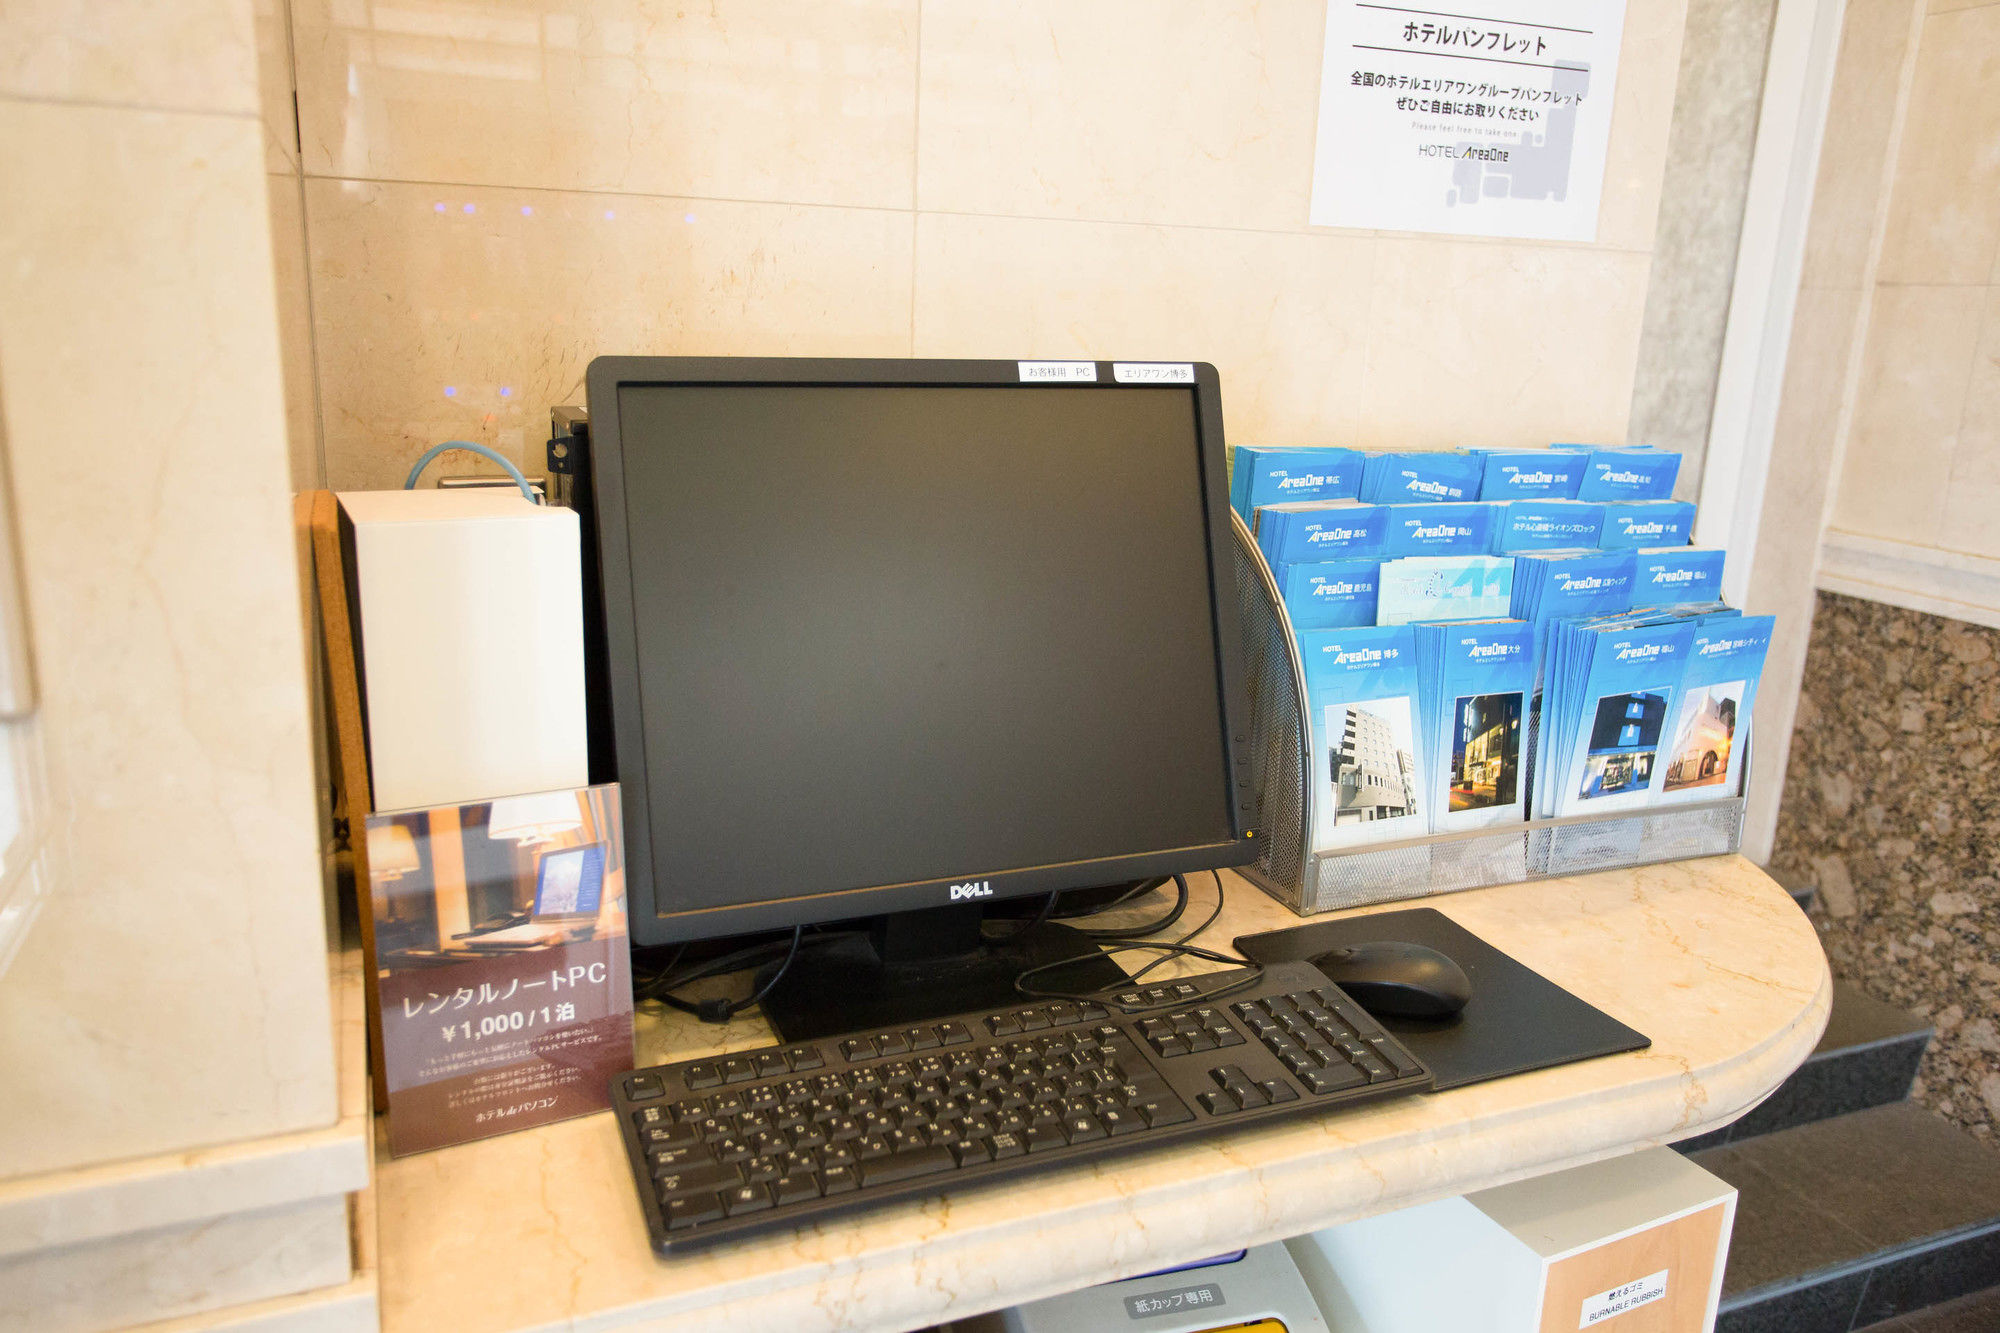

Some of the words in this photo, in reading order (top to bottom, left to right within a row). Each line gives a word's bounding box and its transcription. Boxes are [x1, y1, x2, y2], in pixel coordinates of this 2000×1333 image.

[1403, 21, 1548, 56] ホテルパンフレット
[1350, 70, 1583, 106] 全国のホテルエリアワングループパンフレット
[1396, 97, 1540, 122] ぜひご自由にお取りください
[1411, 121, 1436, 131] Please
[1440, 123, 1454, 132] feel
[1457, 126, 1472, 134] free
[1485, 129, 1501, 137] take
[1419, 144, 1460, 159] HOTEL
[1461, 146, 1509, 162] AreaOne
[1076, 368, 1090, 377] PC
[1124, 369, 1188, 379] エリアワン博多
[1277, 474, 1324, 489] AreaOne
[1509, 471, 1553, 484] AreaOne
[1406, 479, 1448, 496] AreaOne
[1307, 528, 1352, 543] AreaOne
[1412, 525, 1456, 538] AreaOne
[1560, 577, 1602, 591] AreaOne
[1652, 569, 1693, 583] AreaOne
[1312, 581, 1353, 596] AreaOne
[1333, 648, 1382, 664] AreaOne
[1468, 643, 1507, 657] AreaOne
[1616, 644, 1660, 661] AreaOne
[950, 881, 993, 900] DELL
[403, 962, 606, 1019] レンタルノートPC
[1135, 1289, 1214, 1313] 紙カップ専用
[1589, 1299, 1630, 1321] BURNABLE
[1630, 1287, 1664, 1306] RUBBISH
